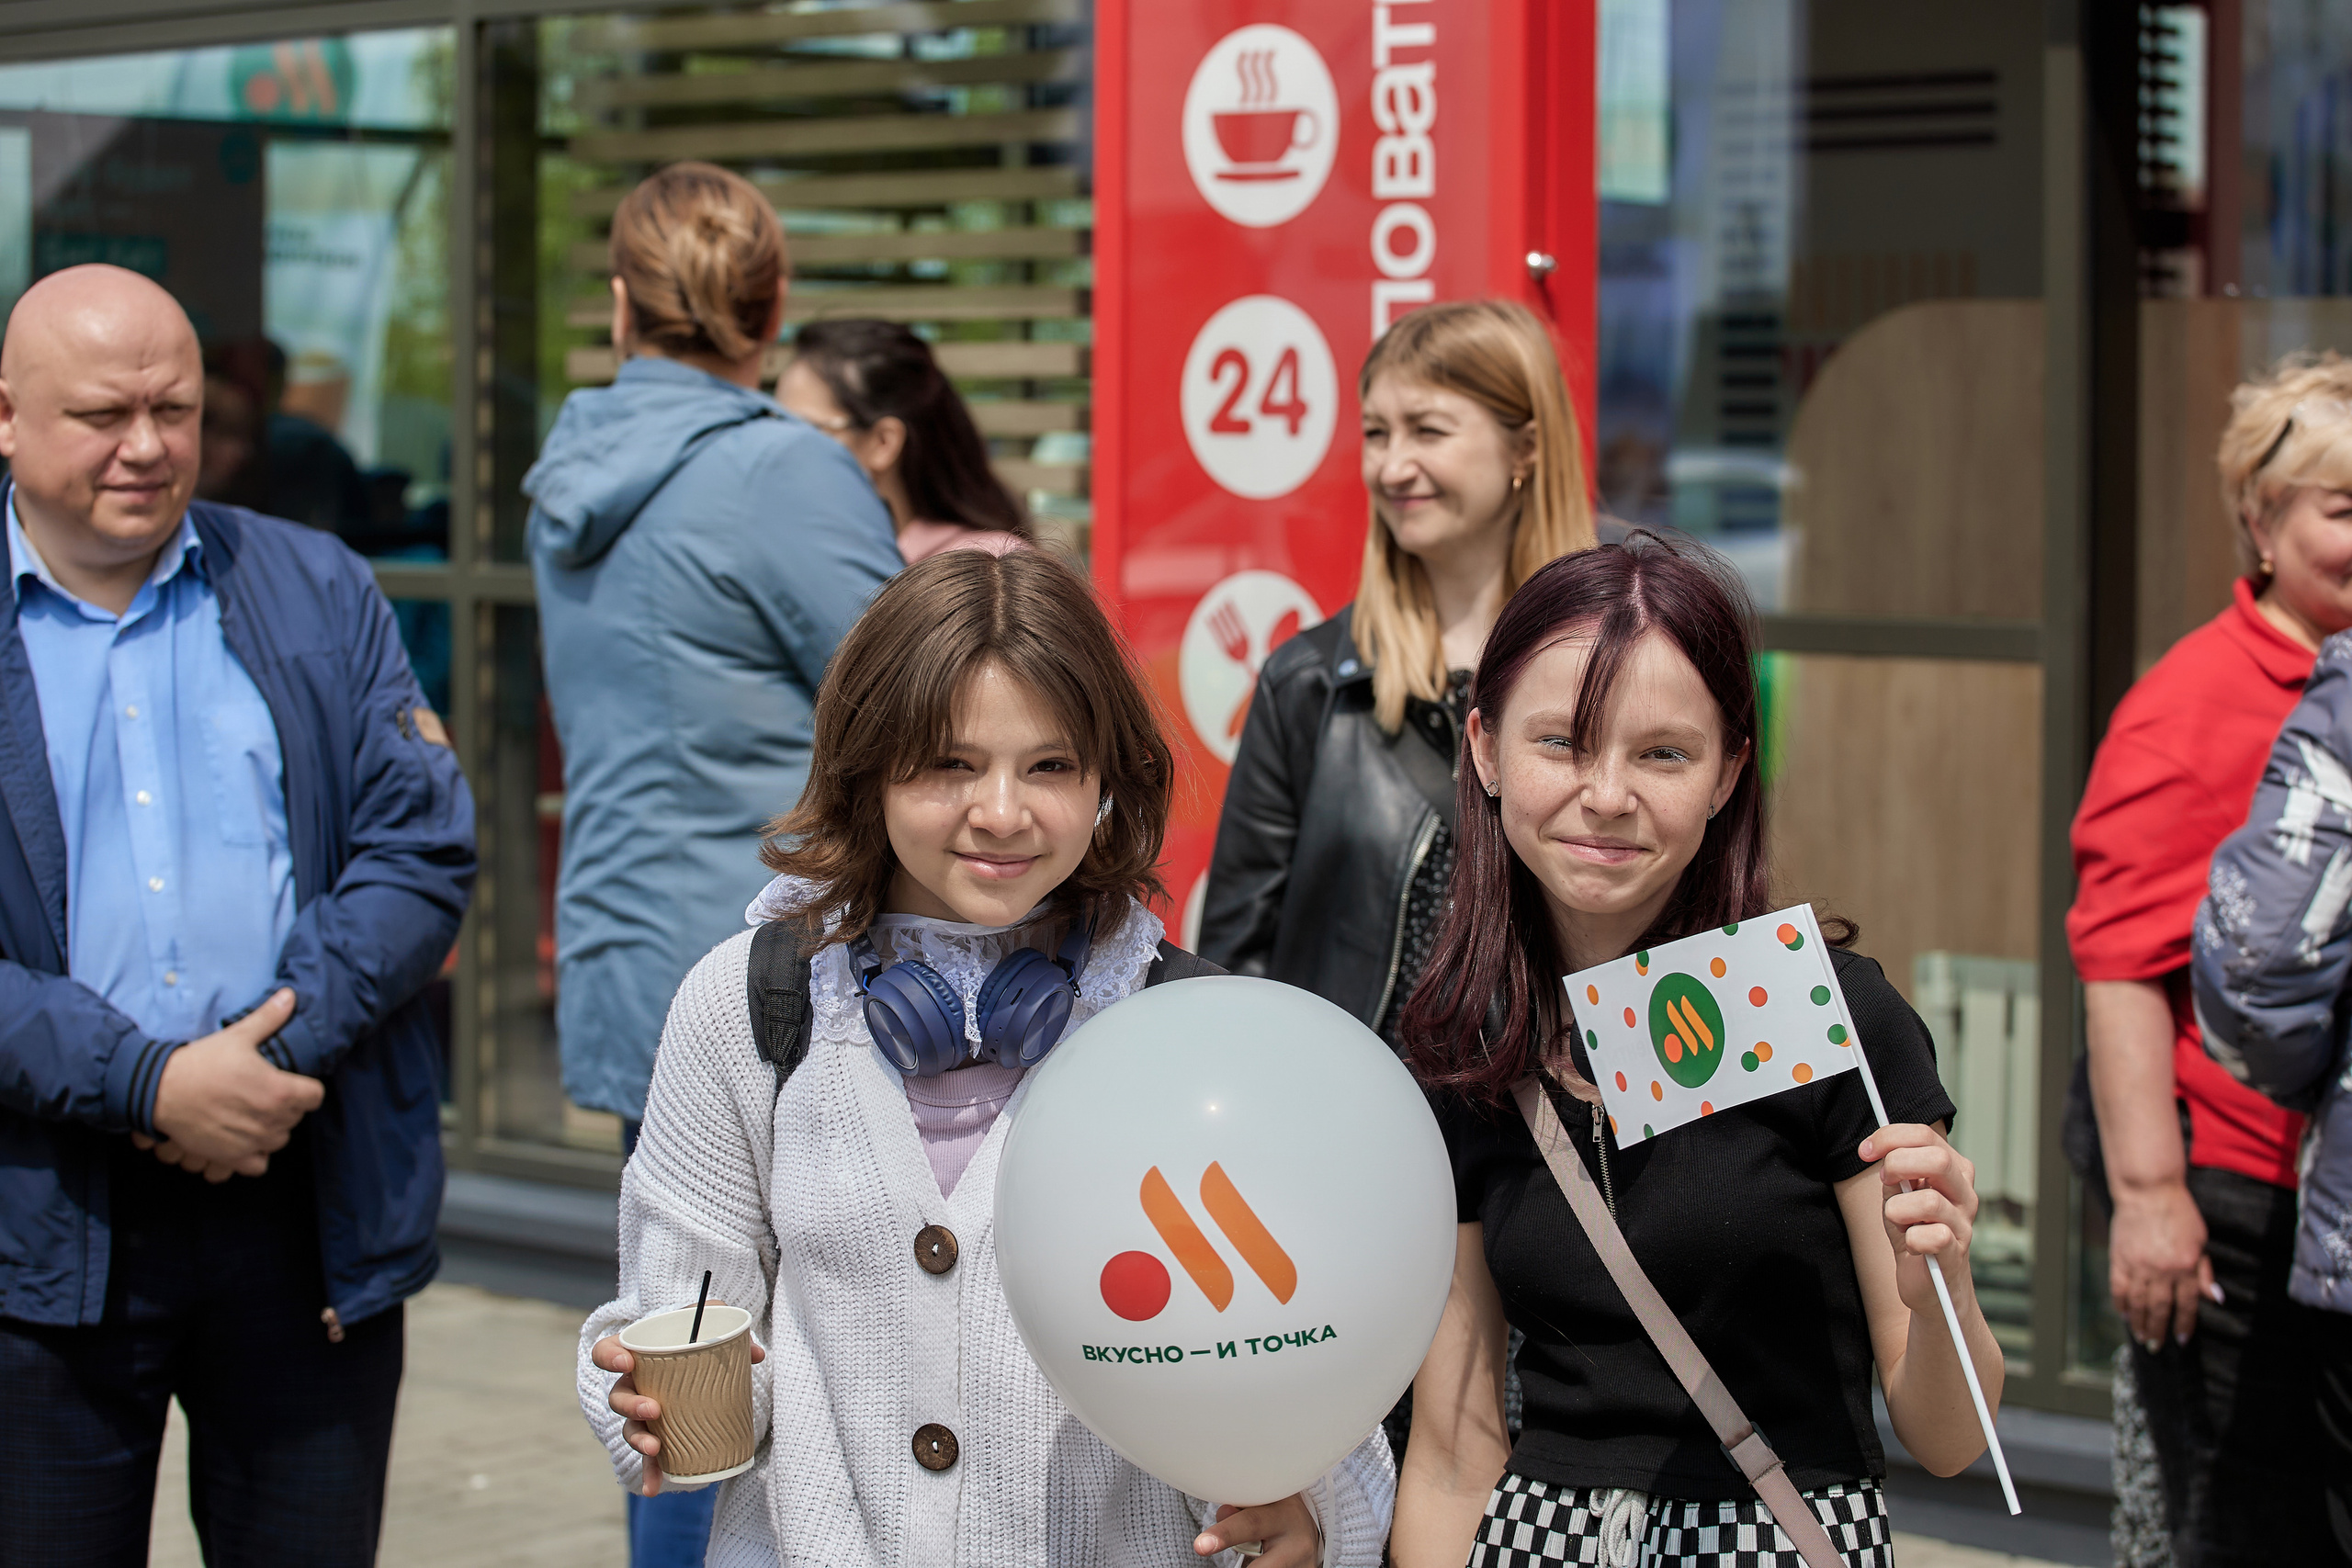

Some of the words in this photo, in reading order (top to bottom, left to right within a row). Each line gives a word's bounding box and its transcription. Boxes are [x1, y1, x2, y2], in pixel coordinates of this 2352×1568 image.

[1371, 0, 1437, 342] оват
[1209, 346, 1306, 436] 24
[1082, 1344, 1183, 1364] ВКУСНО
[1216, 1341, 1238, 1359] И
[1244, 1325, 1338, 1355] ТОЧКА
